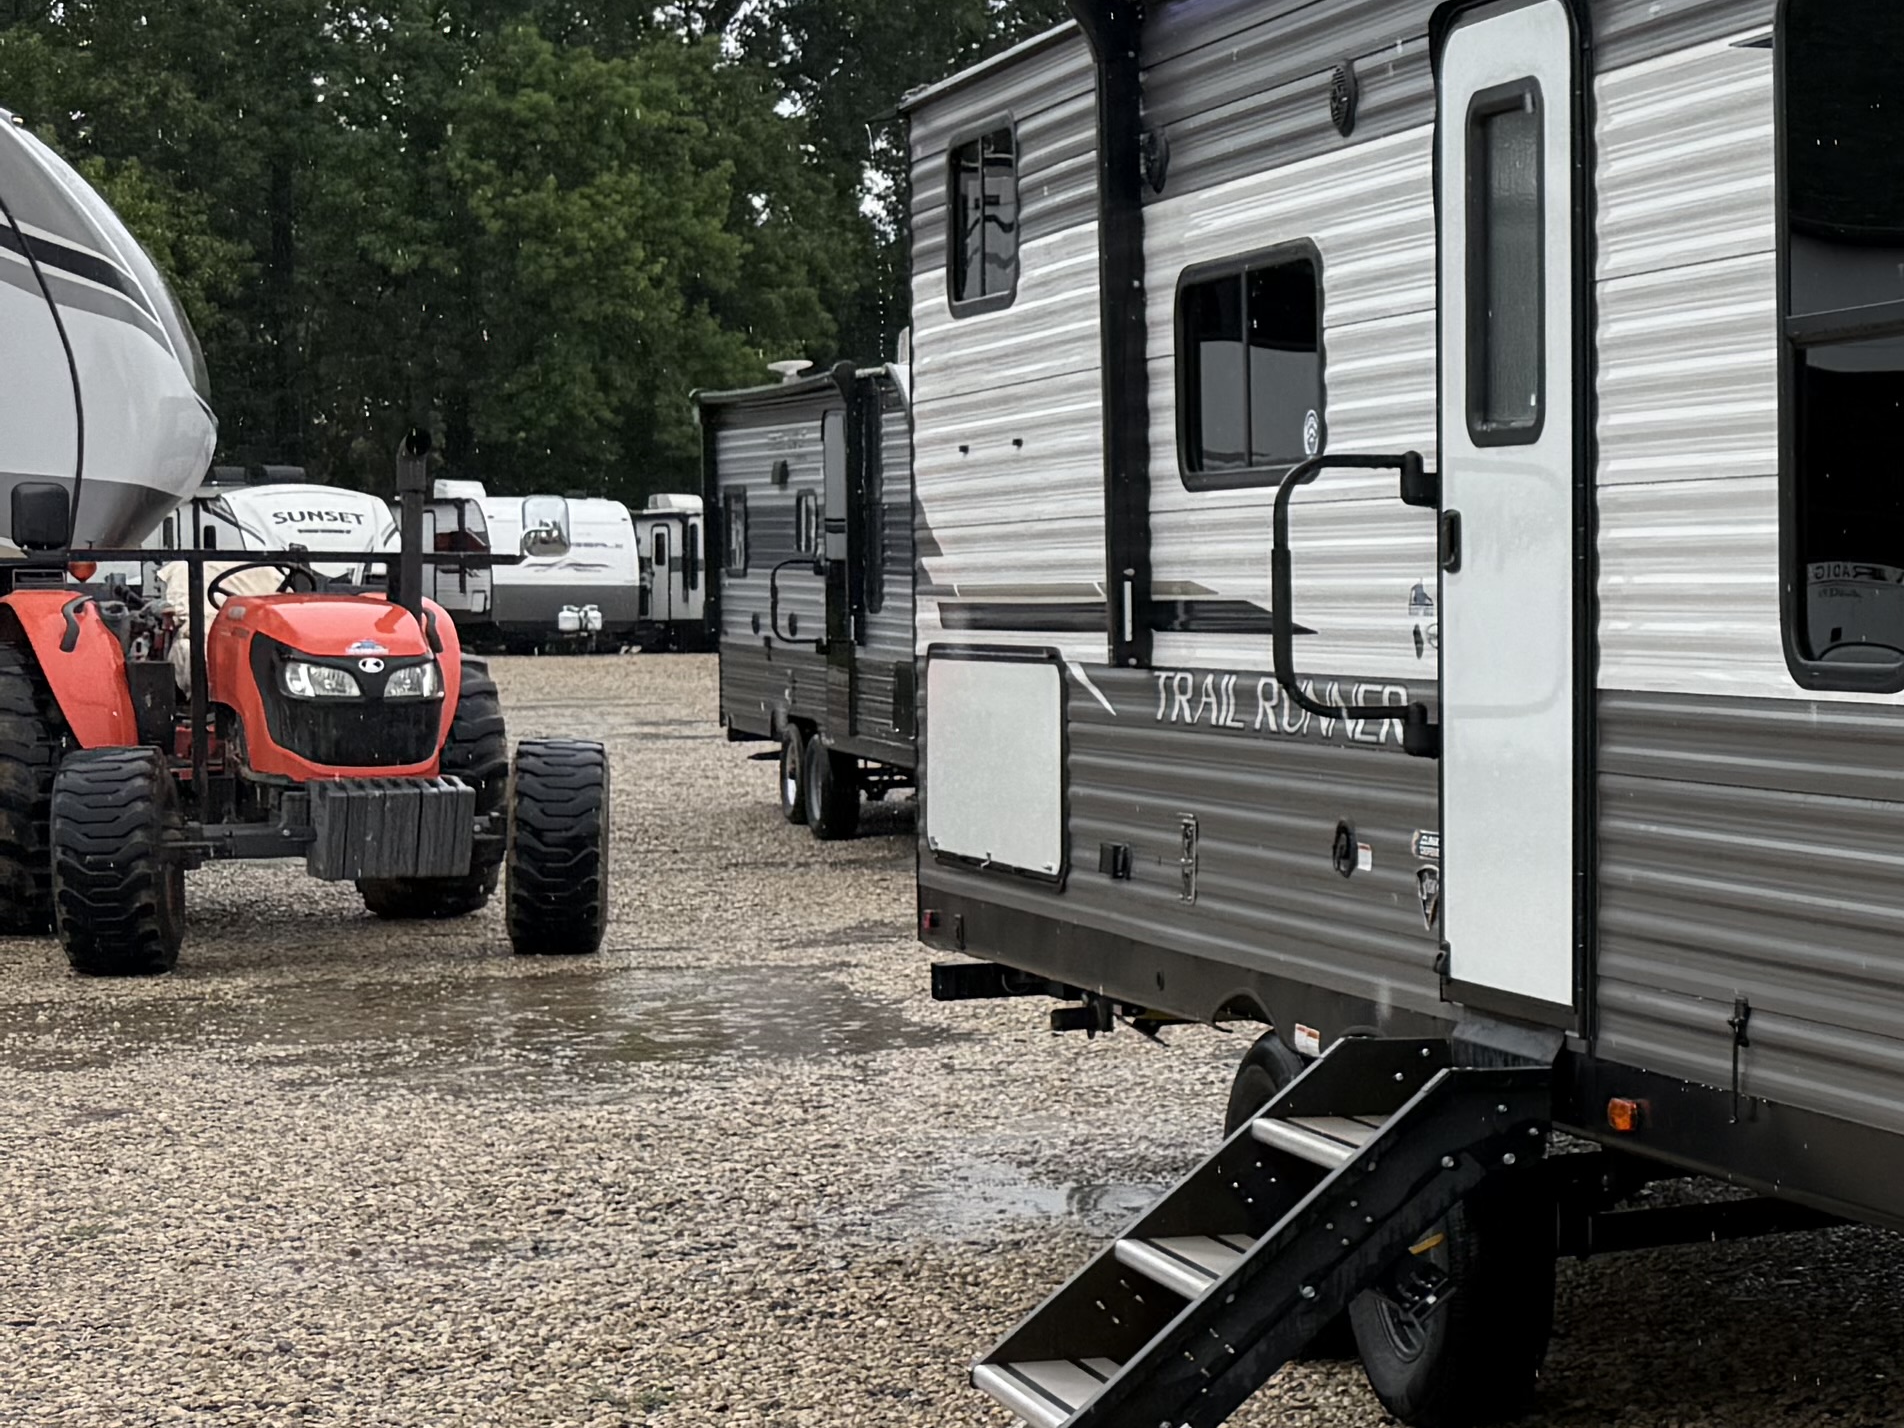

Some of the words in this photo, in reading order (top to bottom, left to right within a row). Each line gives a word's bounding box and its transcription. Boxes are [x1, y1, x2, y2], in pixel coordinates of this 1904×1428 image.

[272, 510, 365, 526] SUNSET
[1153, 671, 1245, 730] TRAIL
[1254, 676, 1409, 745] RUNNER
